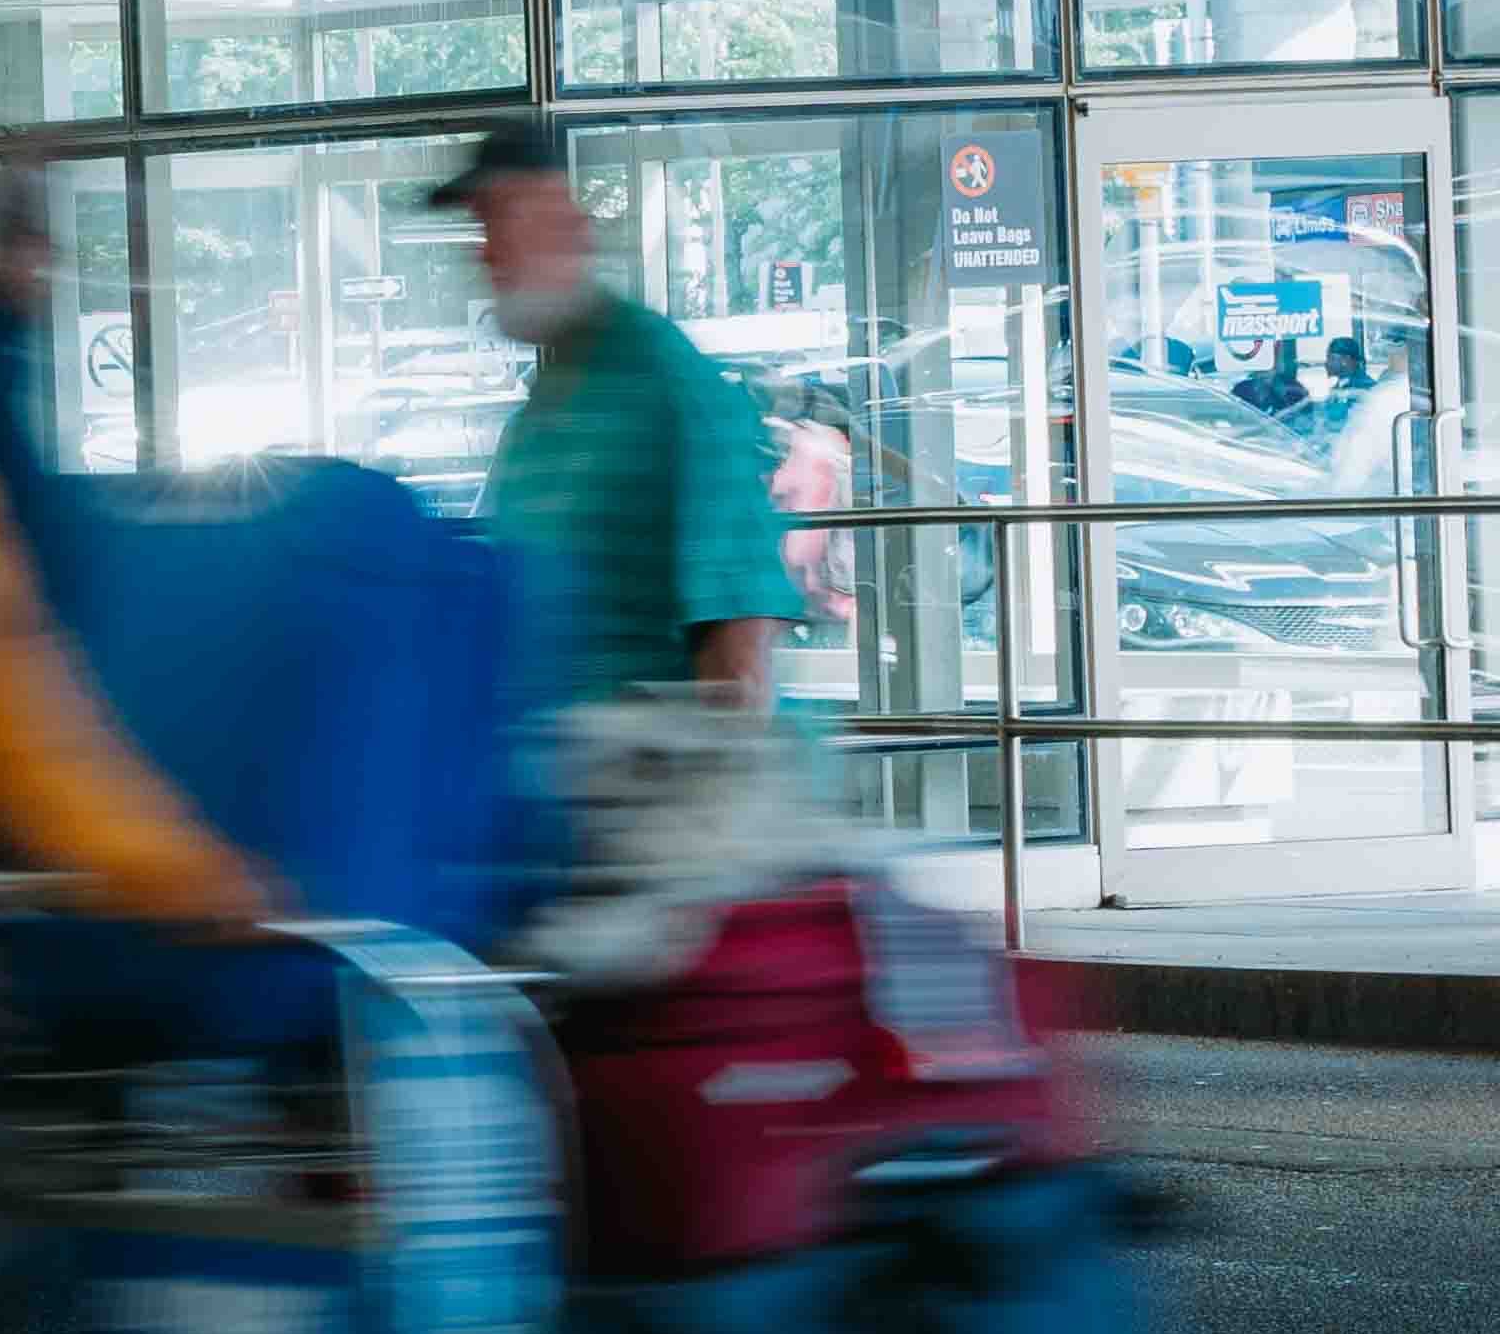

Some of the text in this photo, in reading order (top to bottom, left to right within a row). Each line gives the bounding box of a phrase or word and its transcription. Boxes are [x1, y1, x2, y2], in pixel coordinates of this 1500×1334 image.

[951, 207, 999, 225] Do Not
[953, 226, 1032, 245] Leave Bags
[954, 249, 1040, 267] UNATTENDED
[1223, 310, 1319, 338] massport
